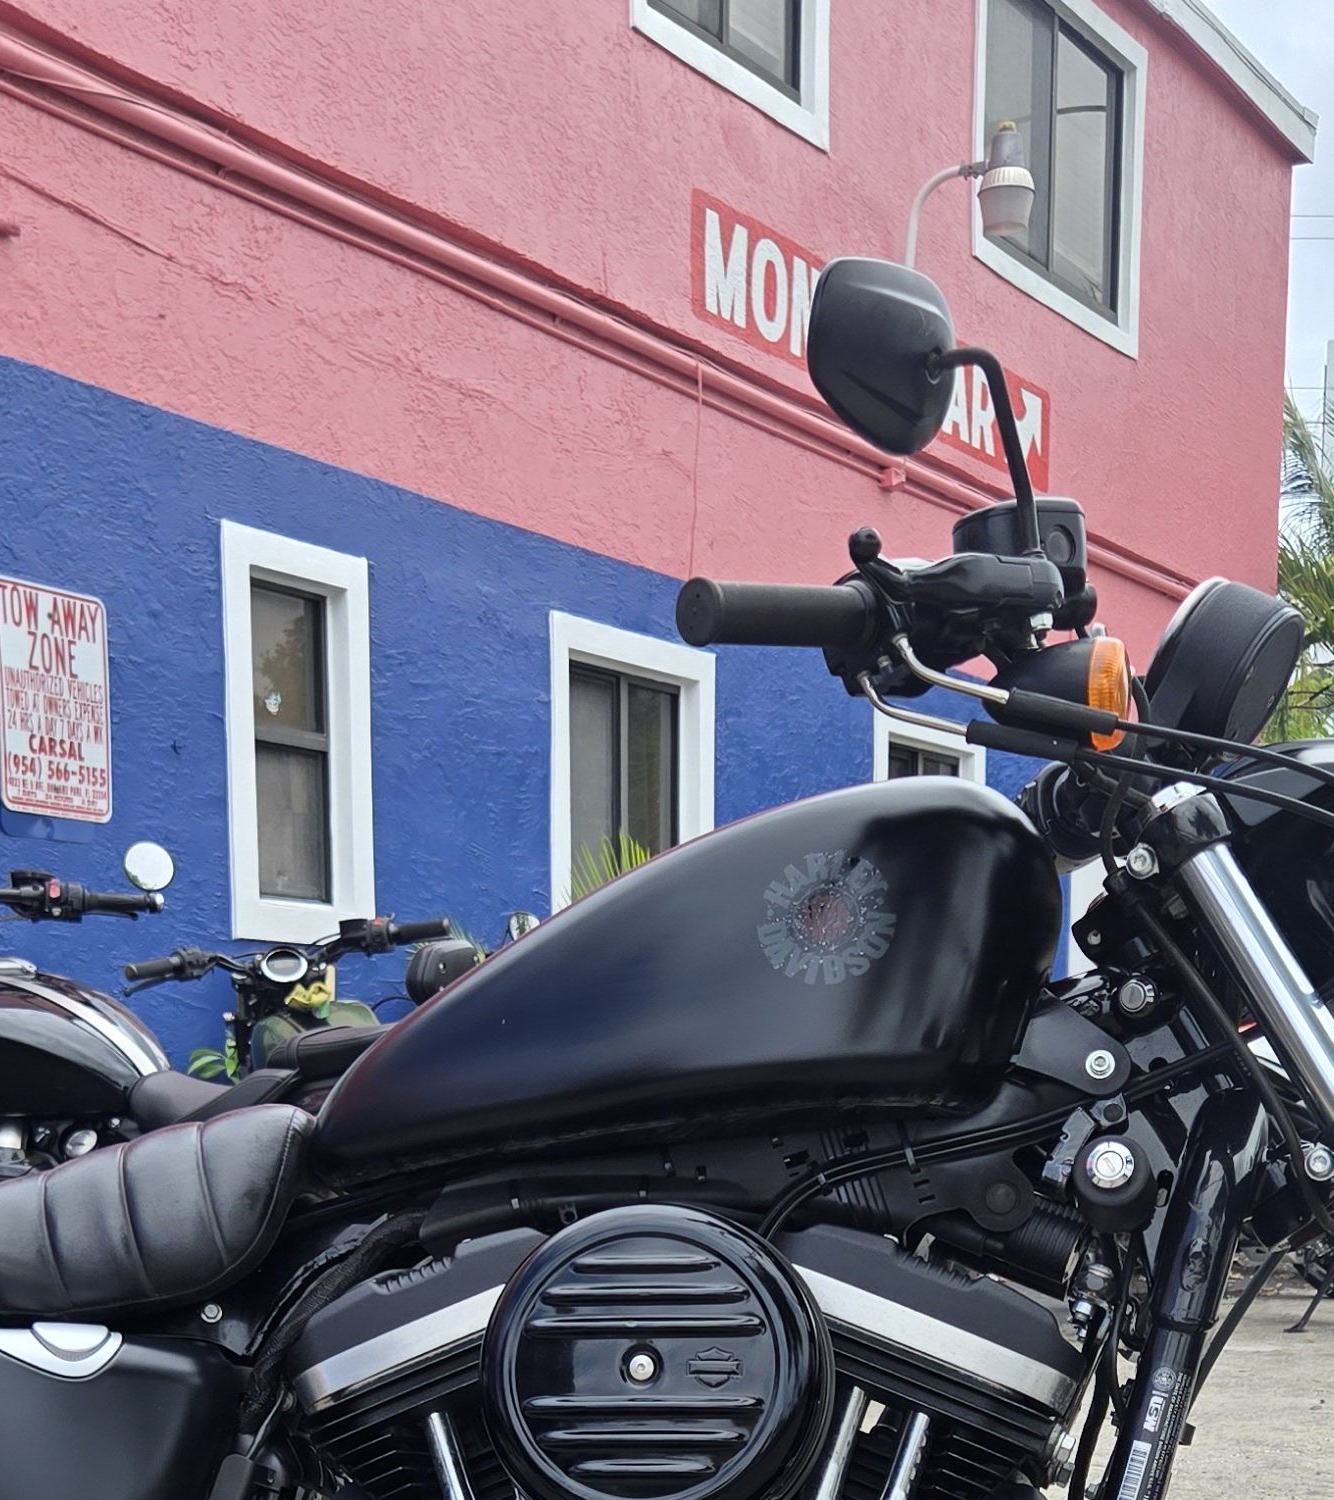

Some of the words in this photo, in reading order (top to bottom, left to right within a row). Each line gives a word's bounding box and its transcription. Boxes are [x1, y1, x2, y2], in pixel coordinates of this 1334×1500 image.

[704, 207, 821, 358] MON
[941, 363, 997, 458] AR
[49, 597, 99, 644] AWAY
[27, 631, 78, 678] ZONE
[3, 666, 64, 696] UNAUTHORIZED
[67, 680, 103, 704] VEHICLES
[5, 688, 30, 711] TOWED
[31, 693, 40, 713] AT
[74, 701, 104, 725] EXPENSE
[6, 709, 17, 730] 24
[19, 711, 34, 733] HRS
[36, 714, 43, 735] A
[44, 716, 58, 737] DAY
[59, 719, 65, 739] 7
[66, 720, 83, 742] DAYS
[85, 724, 91, 743] A
[27, 734, 85, 761] CARSAL
[7, 752, 42, 779] (954)
[46, 760, 106, 787] 566-5155
[757, 911, 897, 985] DAVIDSON
